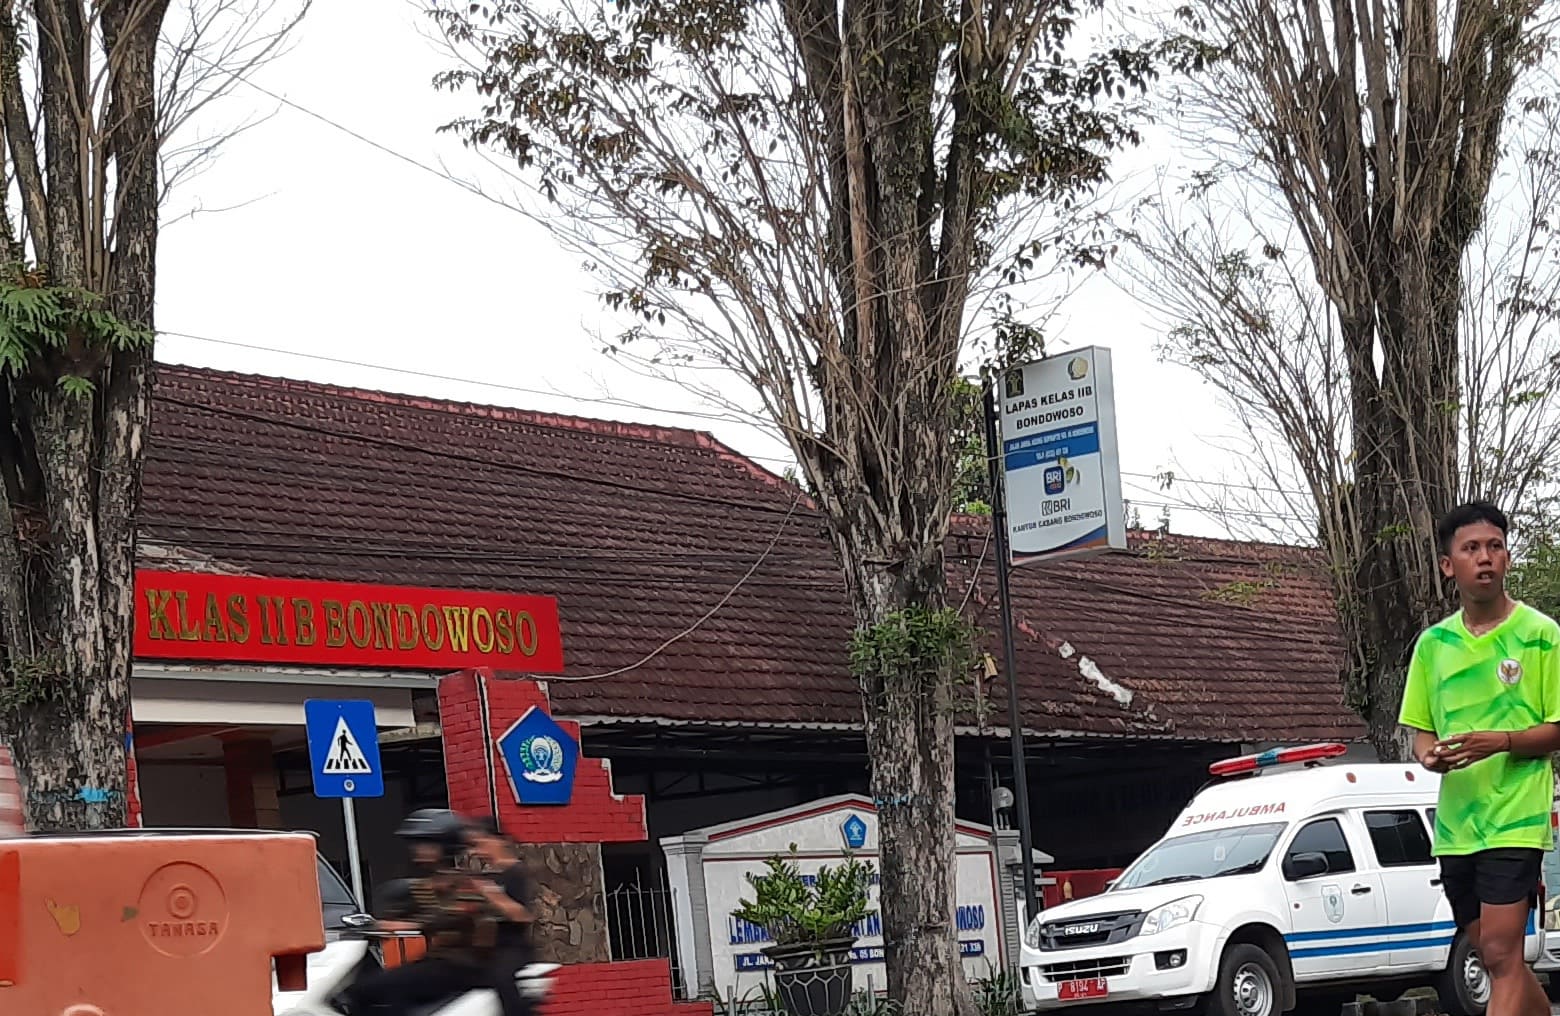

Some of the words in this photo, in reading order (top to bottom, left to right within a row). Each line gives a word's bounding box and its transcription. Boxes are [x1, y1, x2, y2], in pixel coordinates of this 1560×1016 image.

[1006, 399, 1037, 414] LAPAS
[1040, 389, 1075, 406] KELAS
[1077, 386, 1092, 398] IIB
[1016, 406, 1083, 429] BONDOWOSO
[1053, 498, 1071, 513] BRI
[145, 589, 250, 643] KLAS
[322, 601, 539, 656] BONDOWOSO
[148, 922, 219, 937] TANASA
[1065, 923, 1098, 936] ISUZU
